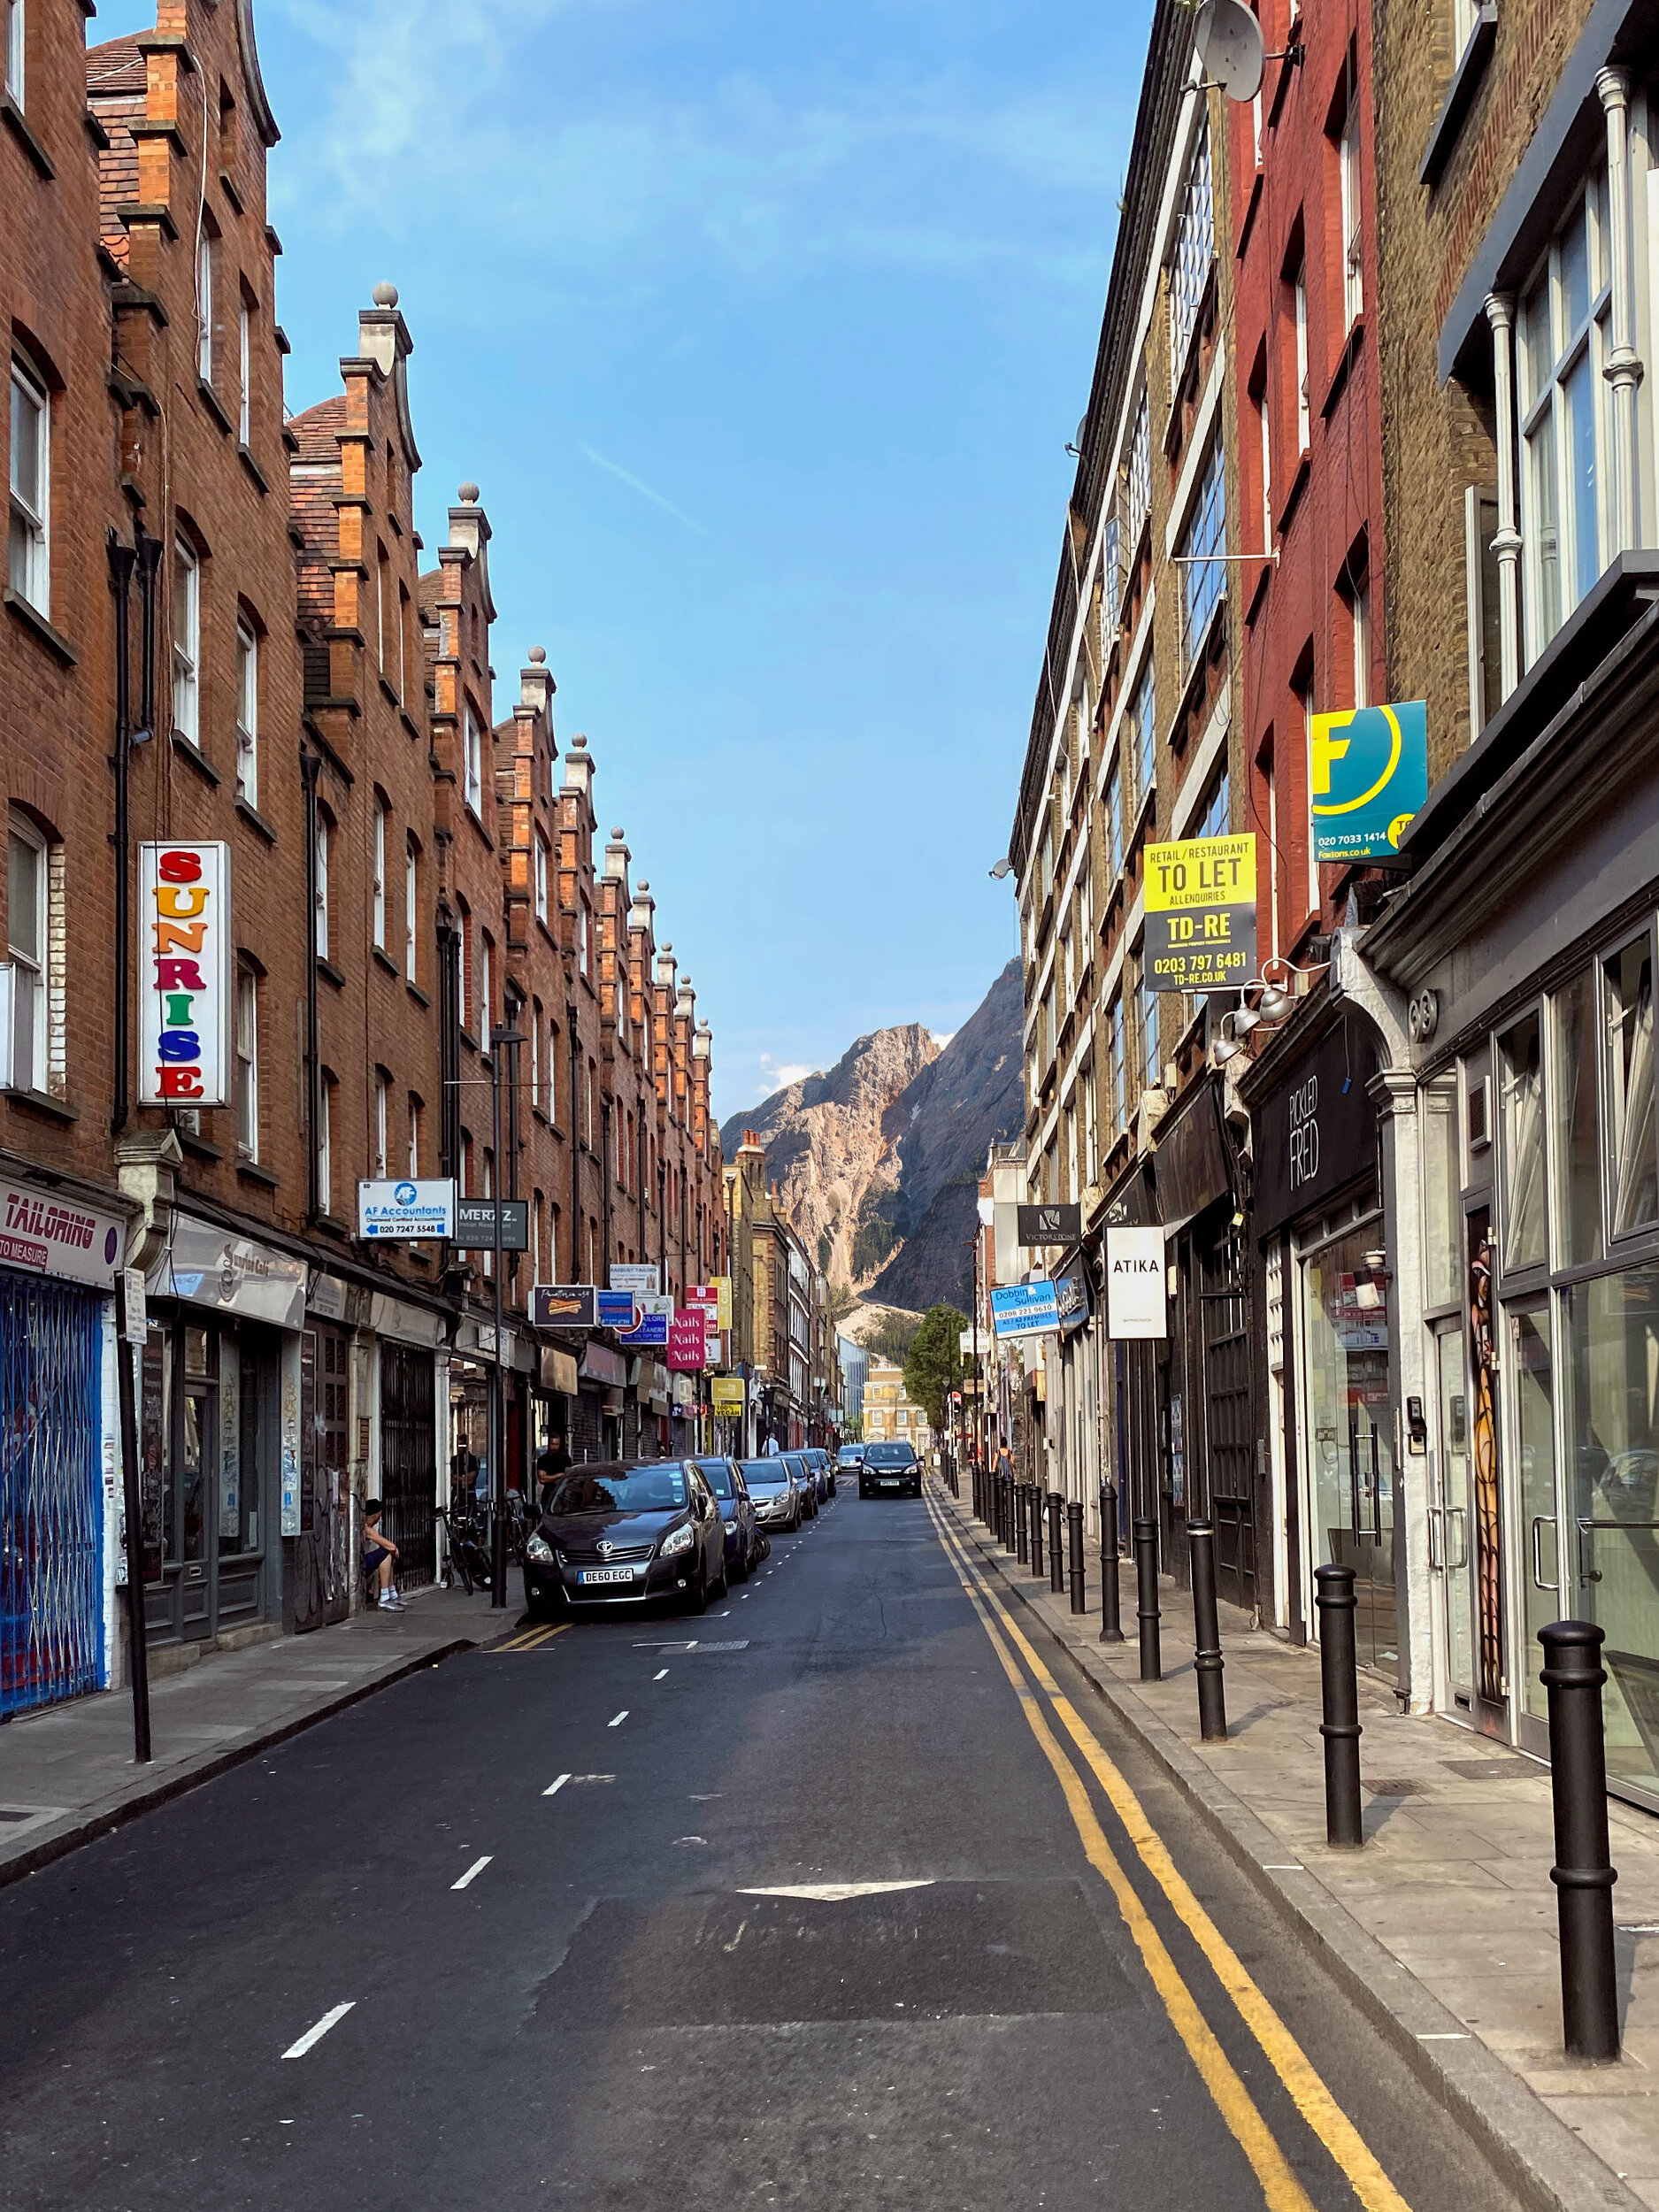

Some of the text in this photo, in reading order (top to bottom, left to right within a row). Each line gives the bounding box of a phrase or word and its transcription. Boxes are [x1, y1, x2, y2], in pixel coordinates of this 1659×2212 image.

[1318, 837, 1336, 847] 020
[1338, 834, 1361, 844] 7033
[1363, 832, 1386, 842] 1414
[1158, 858, 1241, 893] TO LET
[1167, 913, 1231, 941] TD-RE
[1154, 952, 1247, 974] 0203 797 6481
[151, 851, 210, 1097] SUNRISE
[1173, 971, 1226, 986] TD-RE.CO.UK
[1289, 1074, 1318, 1131] PICKLED
[1290, 1118, 1319, 1192] FRED
[381, 1206, 446, 1215] Accountants
[5, 1194, 96, 1249] TAILORING
[0, 1240, 47, 1264] TO MEASURE
[1114, 1260, 1159, 1272] ATIKA
[995, 1288, 1028, 1301] Dobbin
[1015, 1294, 1051, 1306] Sullivan
[674, 1317, 700, 1328] Nails
[672, 1333, 700, 1345] Nails
[672, 1350, 700, 1362] Nails
[586, 1571, 631, 1582] DE60 EGC
